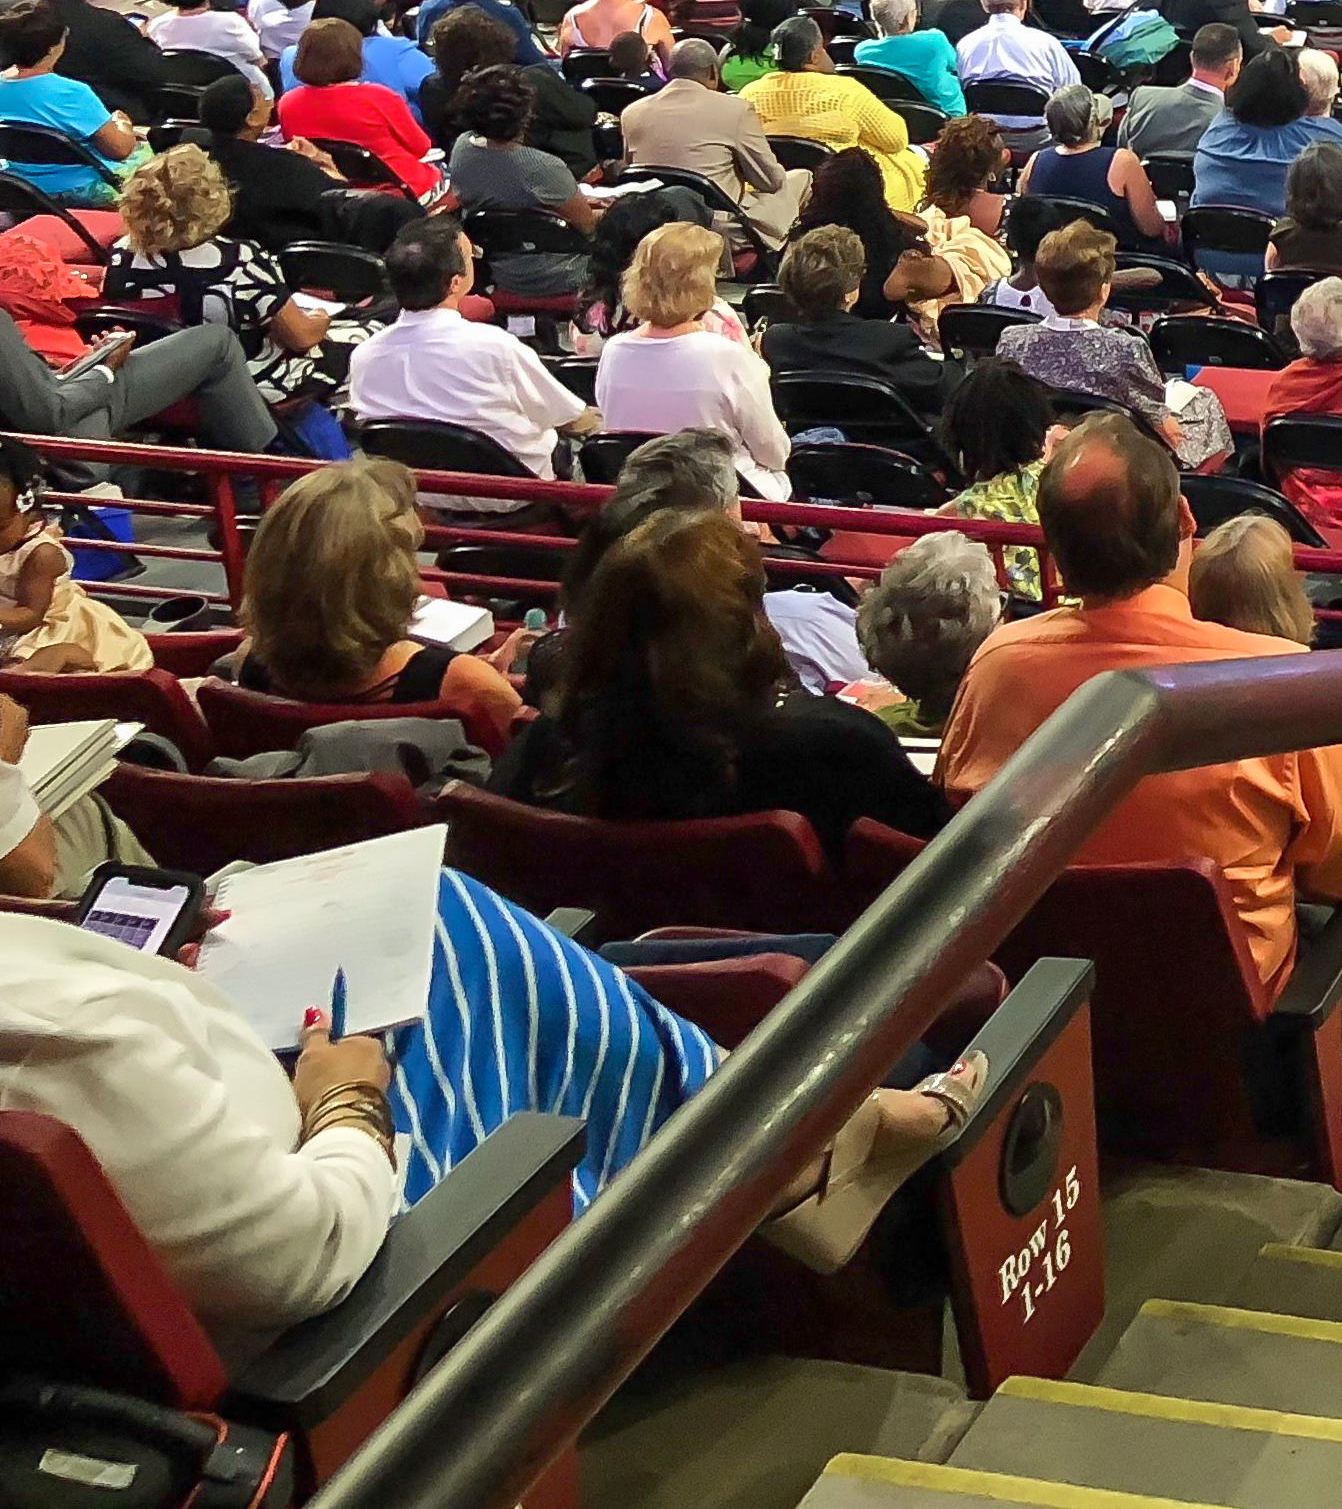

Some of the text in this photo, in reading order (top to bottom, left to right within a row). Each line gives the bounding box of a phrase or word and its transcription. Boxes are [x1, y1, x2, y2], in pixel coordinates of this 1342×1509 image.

[998, 1164, 1081, 1306] Row 15
[1020, 1229, 1072, 1325] 1-16
